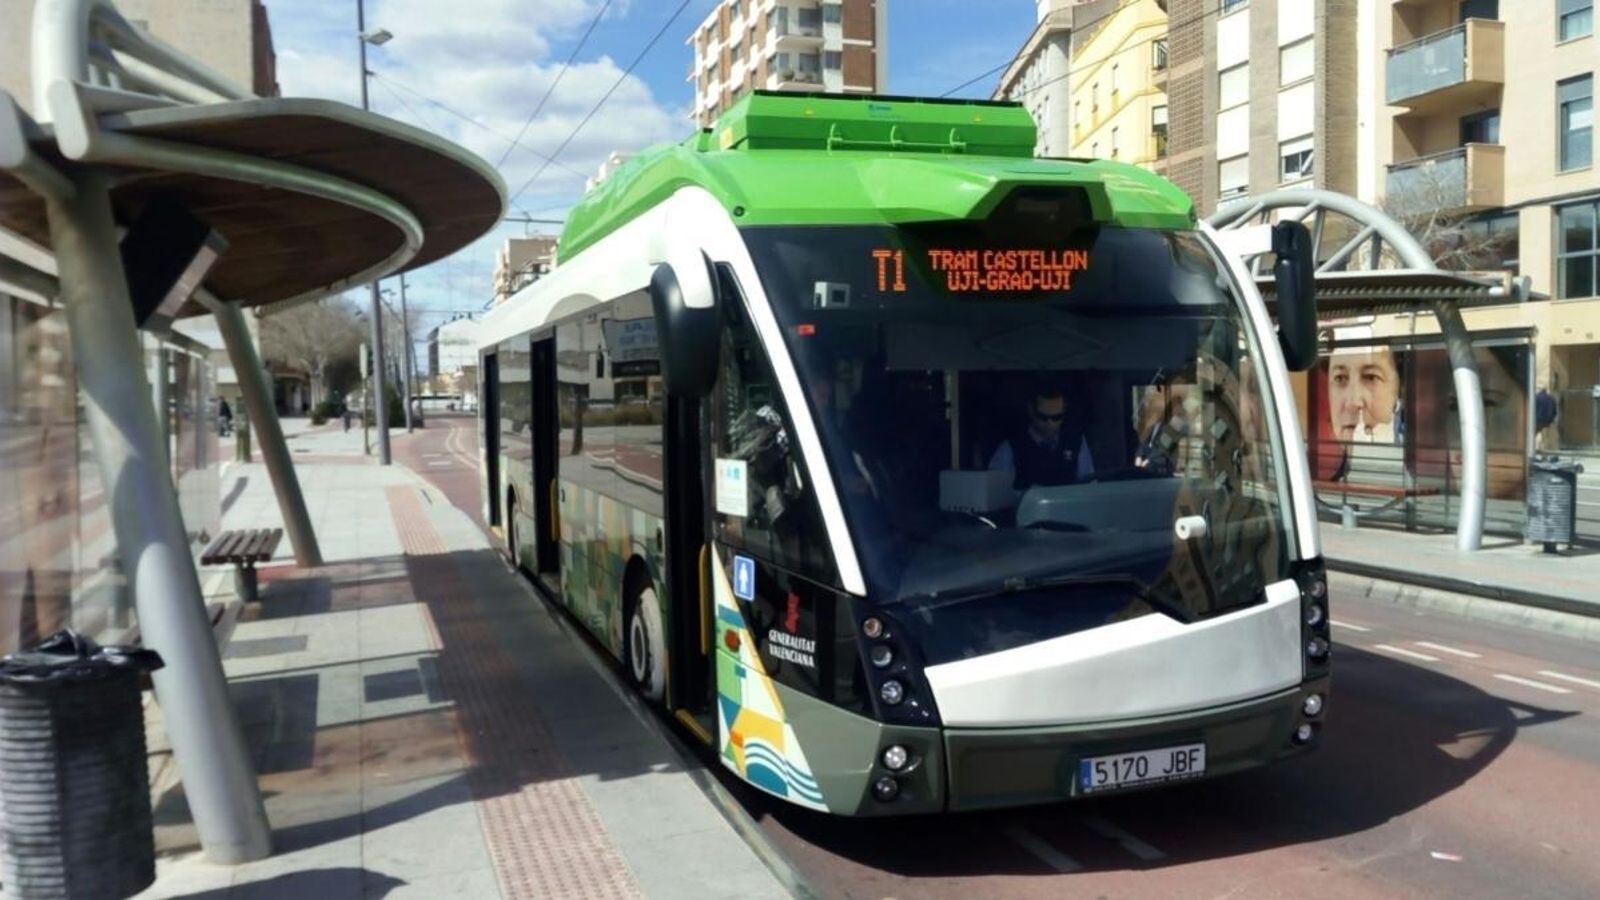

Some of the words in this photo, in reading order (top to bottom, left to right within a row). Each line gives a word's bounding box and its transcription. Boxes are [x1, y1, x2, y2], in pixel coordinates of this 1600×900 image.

[872, 250, 906, 291] T1
[928, 250, 978, 270] TRAM
[983, 250, 1088, 270] CASTELLON
[947, 270, 1071, 291] UJI-GRAO-UJI
[768, 629, 816, 653] GENERALITAT
[769, 643, 814, 667] VALENCIANA
[1096, 756, 1148, 784] 5170
[1163, 749, 1200, 774] JBF
